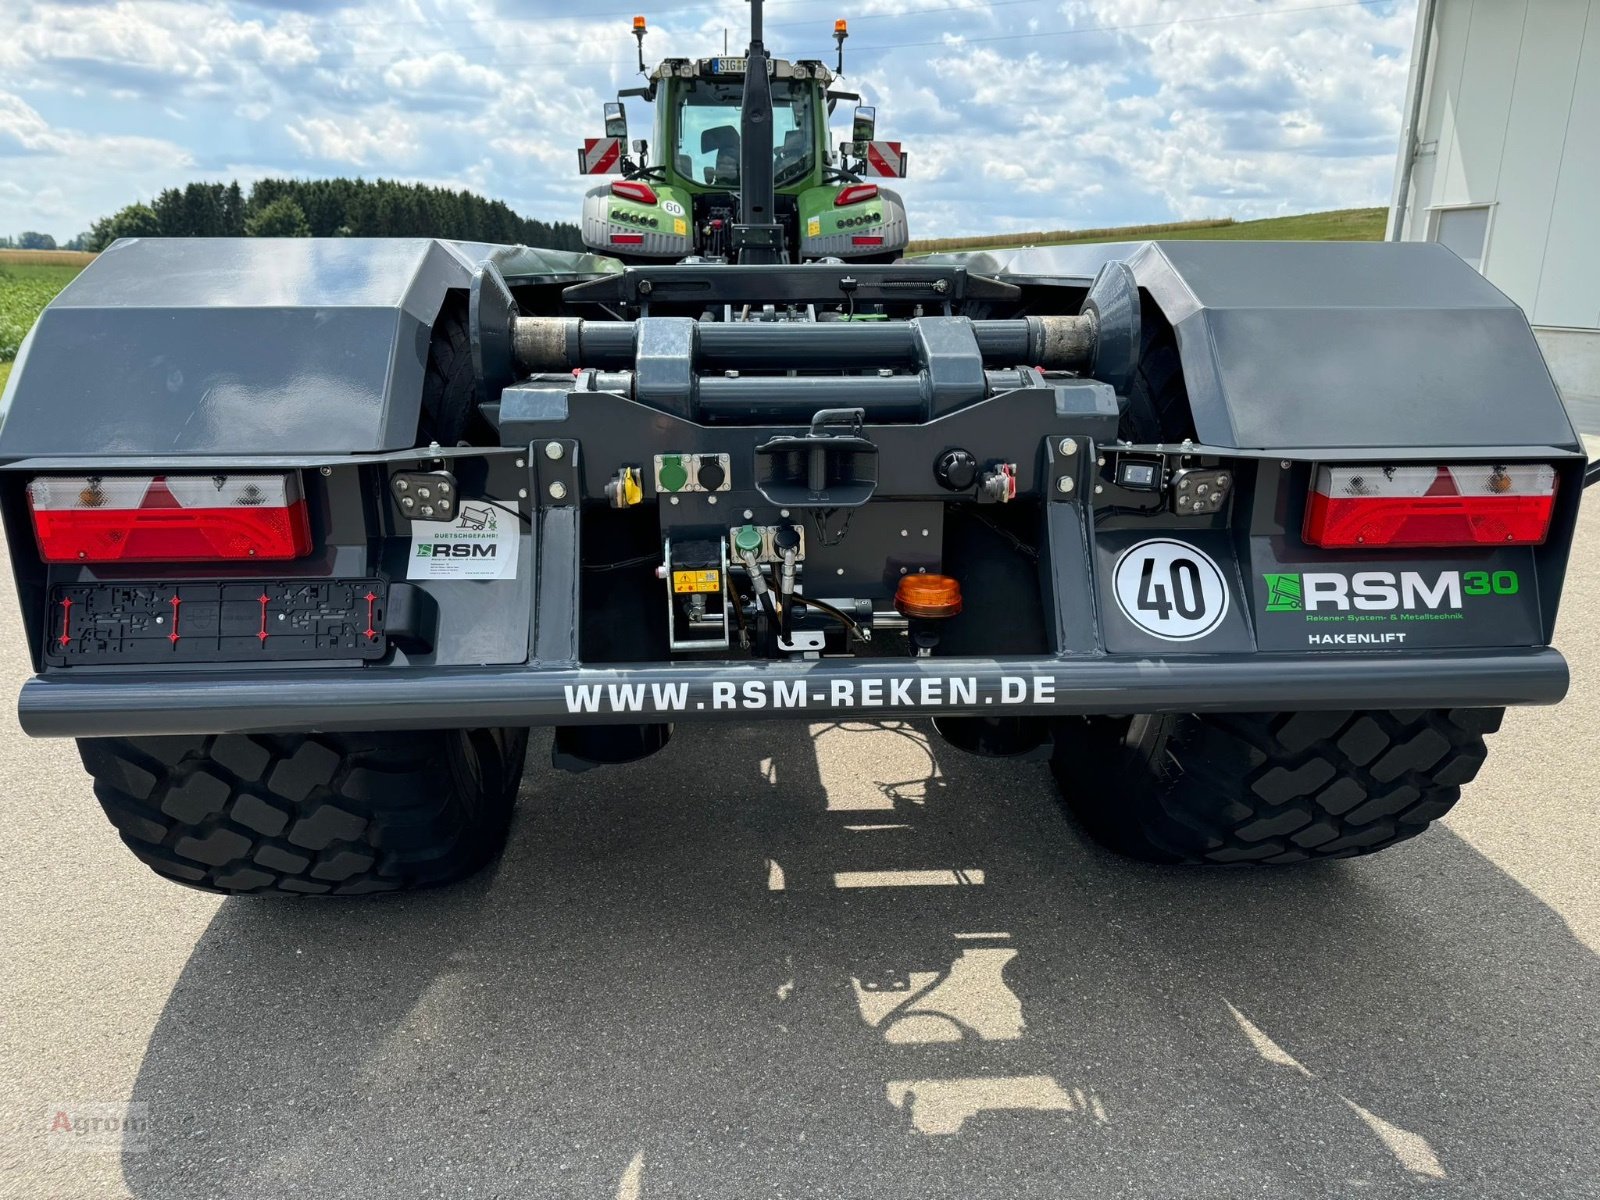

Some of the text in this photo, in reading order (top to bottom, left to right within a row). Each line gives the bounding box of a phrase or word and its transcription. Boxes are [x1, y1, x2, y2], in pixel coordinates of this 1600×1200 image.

[720, 60, 735, 71] SIG
[666, 202, 680, 213] 60
[432, 543, 497, 557] RSM
[1137, 557, 1206, 622] 40
[1305, 613, 1464, 623] Rekener System- & Metalltechnik
[1308, 632, 1407, 645] HAKENLIFT
[564, 676, 1057, 714] WWW.RSM-REKEN.DE
